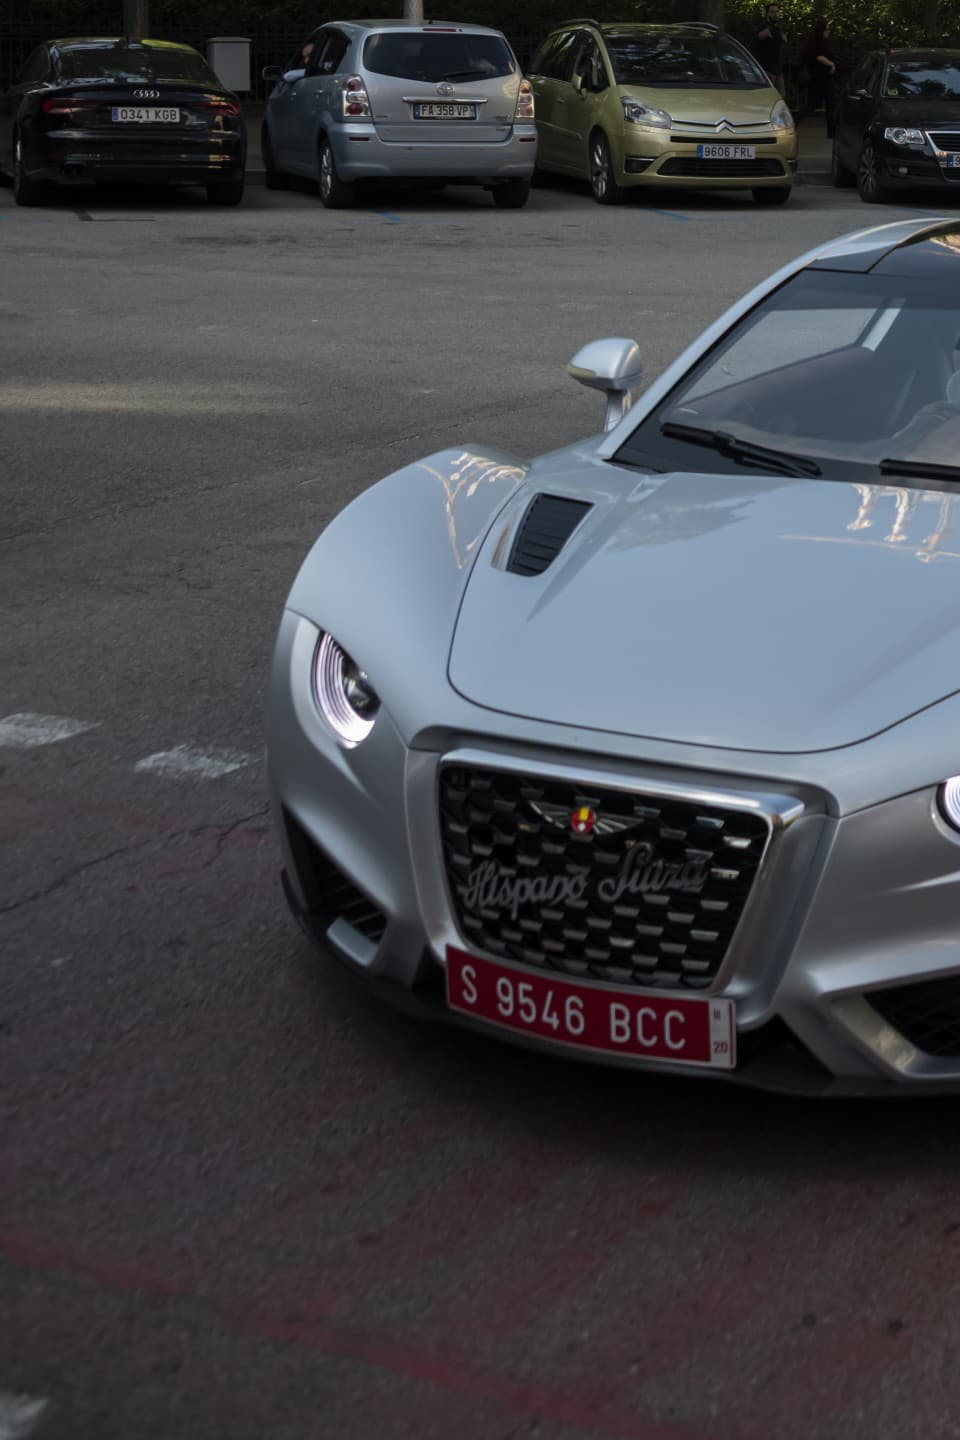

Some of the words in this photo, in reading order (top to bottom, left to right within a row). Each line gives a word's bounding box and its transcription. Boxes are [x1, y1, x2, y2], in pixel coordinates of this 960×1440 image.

[120, 109, 150, 120] 0341
[154, 109, 177, 120] KGB
[704, 146, 730, 157] 9606
[733, 147, 752, 158] FRL
[463, 859, 588, 922] Hispano
[599, 841, 707, 903] Suiza
[461, 964, 478, 1004] S
[496, 977, 586, 1037] 9546
[609, 1001, 687, 1051] BCC
[713, 1040, 728, 1054] 20
